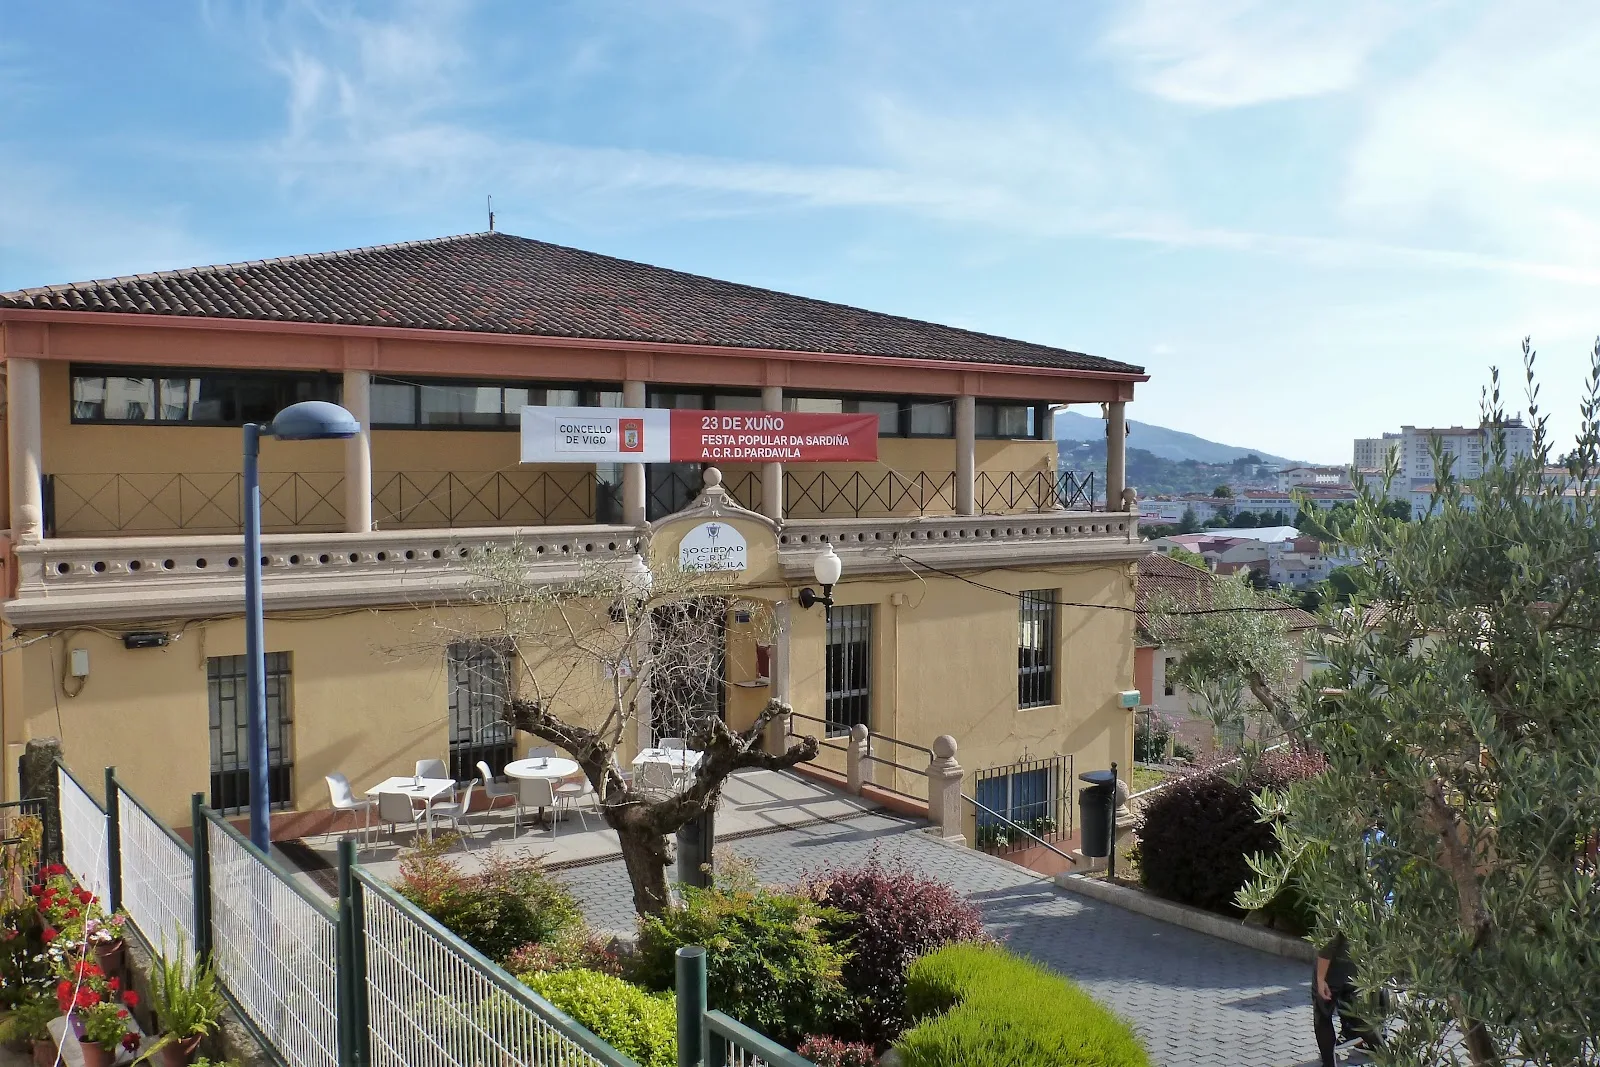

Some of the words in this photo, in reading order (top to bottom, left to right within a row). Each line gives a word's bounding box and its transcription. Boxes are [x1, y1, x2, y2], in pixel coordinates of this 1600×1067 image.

[701, 416, 719, 430] 23
[722, 416, 742, 430] DE
[744, 414, 784, 431] XUÑO
[559, 424, 612, 434] CONCELLO
[566, 435, 580, 444] DE
[582, 435, 606, 445] VIGO
[701, 434, 736, 445] FESTA
[738, 435, 788, 446] POPULAR
[789, 435, 804, 446] DA
[805, 434, 850, 446] SARDIÑA
[701, 447, 801, 458] A.C.R.D.PARDAVILA
[682, 546, 744, 554] SOCIEDAD
